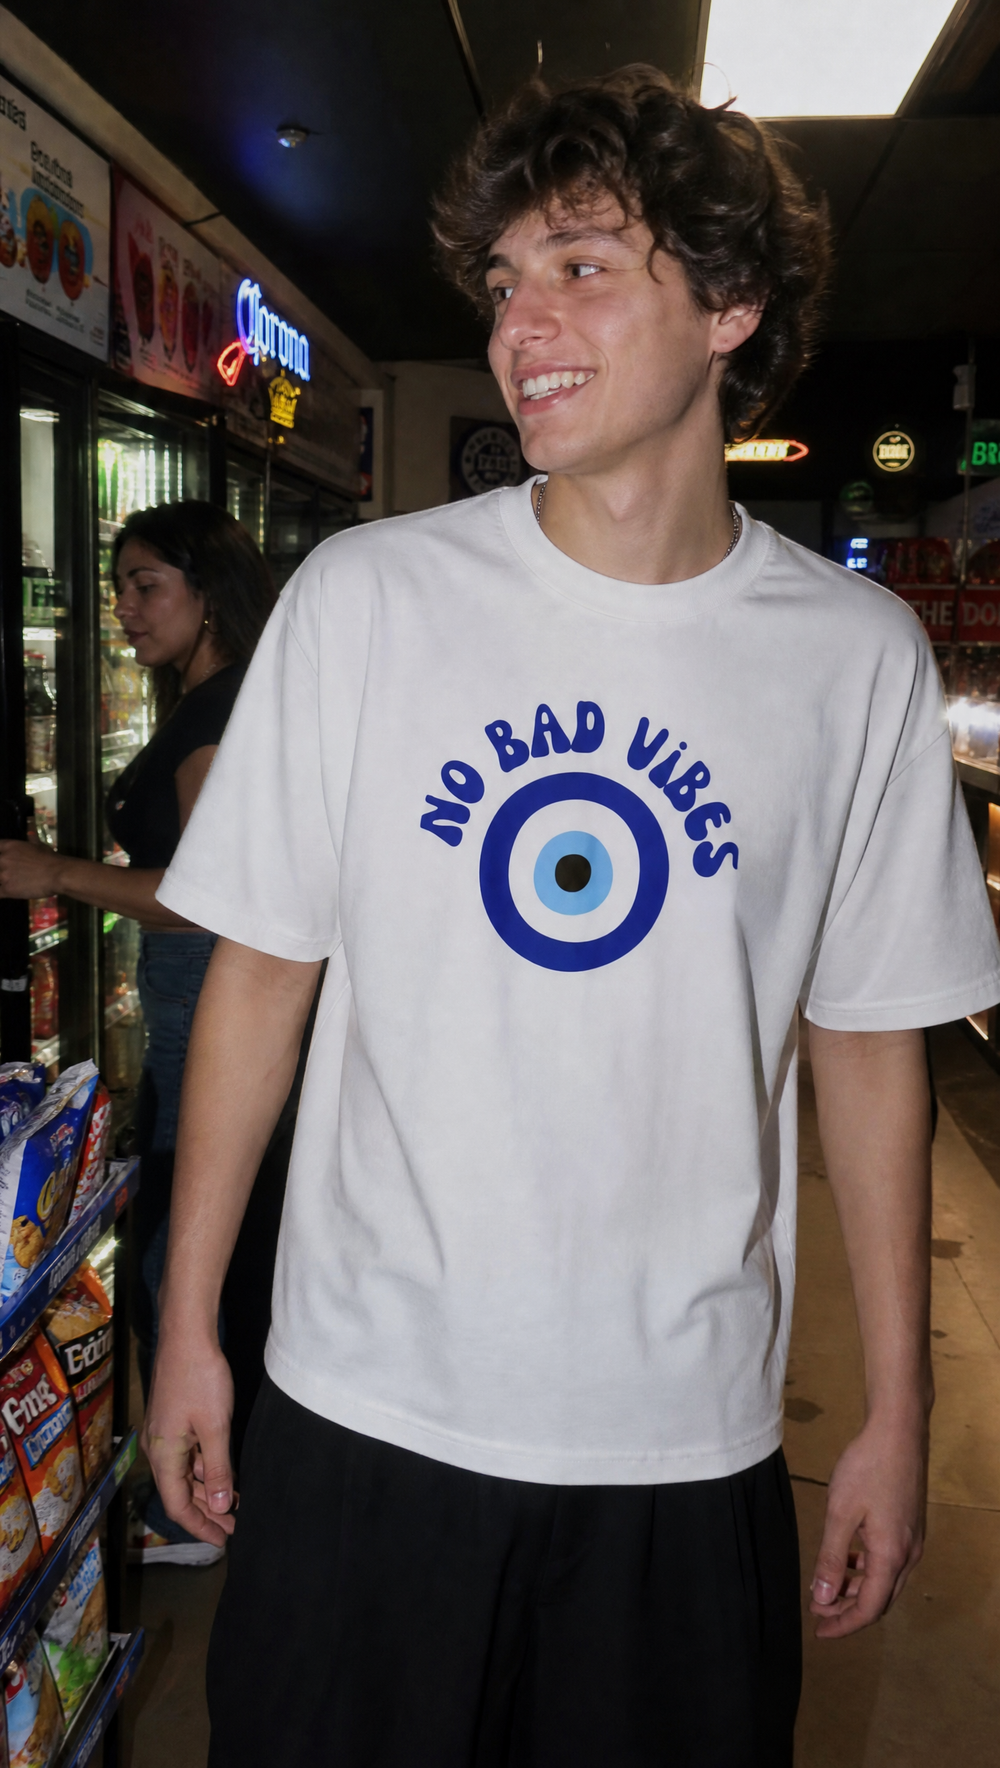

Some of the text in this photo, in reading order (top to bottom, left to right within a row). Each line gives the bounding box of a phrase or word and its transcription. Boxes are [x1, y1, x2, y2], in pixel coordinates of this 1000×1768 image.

[236, 278, 311, 382] Corona
[971, 441, 1000, 466] BR
[962, 601, 1000, 627] DO
[419, 760, 485, 847] NO
[484, 700, 606, 773] BAD
